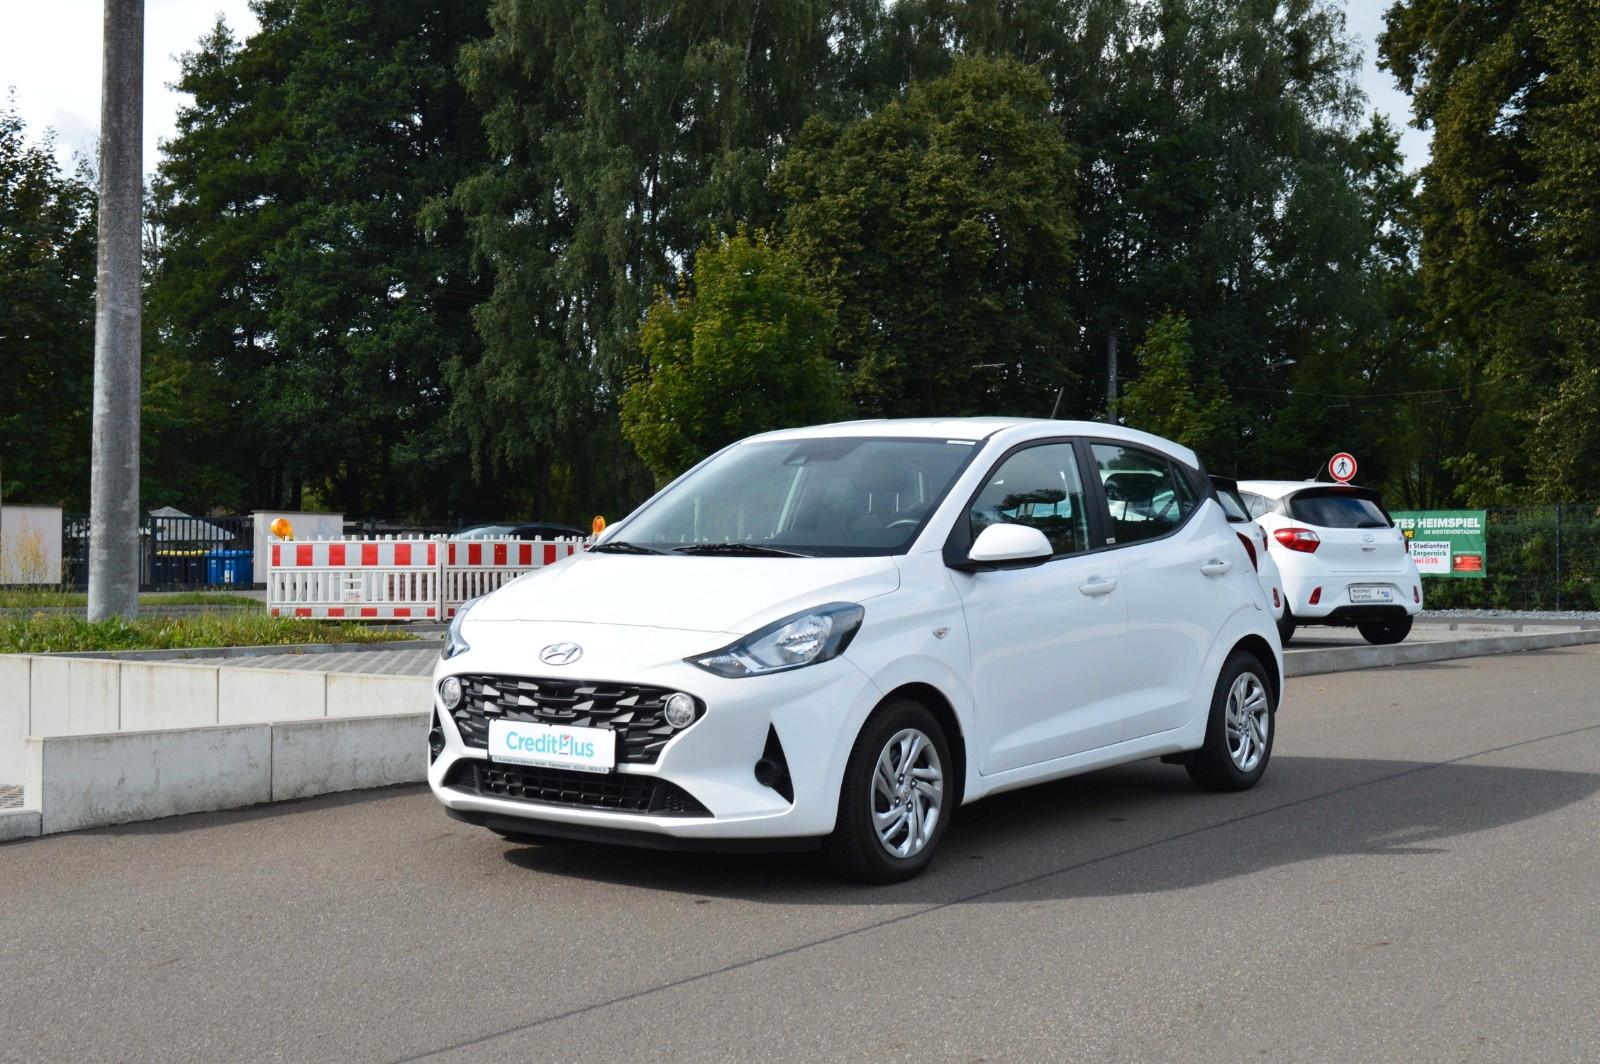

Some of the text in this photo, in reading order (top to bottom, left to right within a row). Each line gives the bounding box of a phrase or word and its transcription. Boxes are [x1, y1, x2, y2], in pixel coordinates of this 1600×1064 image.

[1394, 518, 1480, 529] TES HEIMSPIEL
[1405, 530, 1414, 538] VE
[506, 731, 594, 757] CreditPlus
